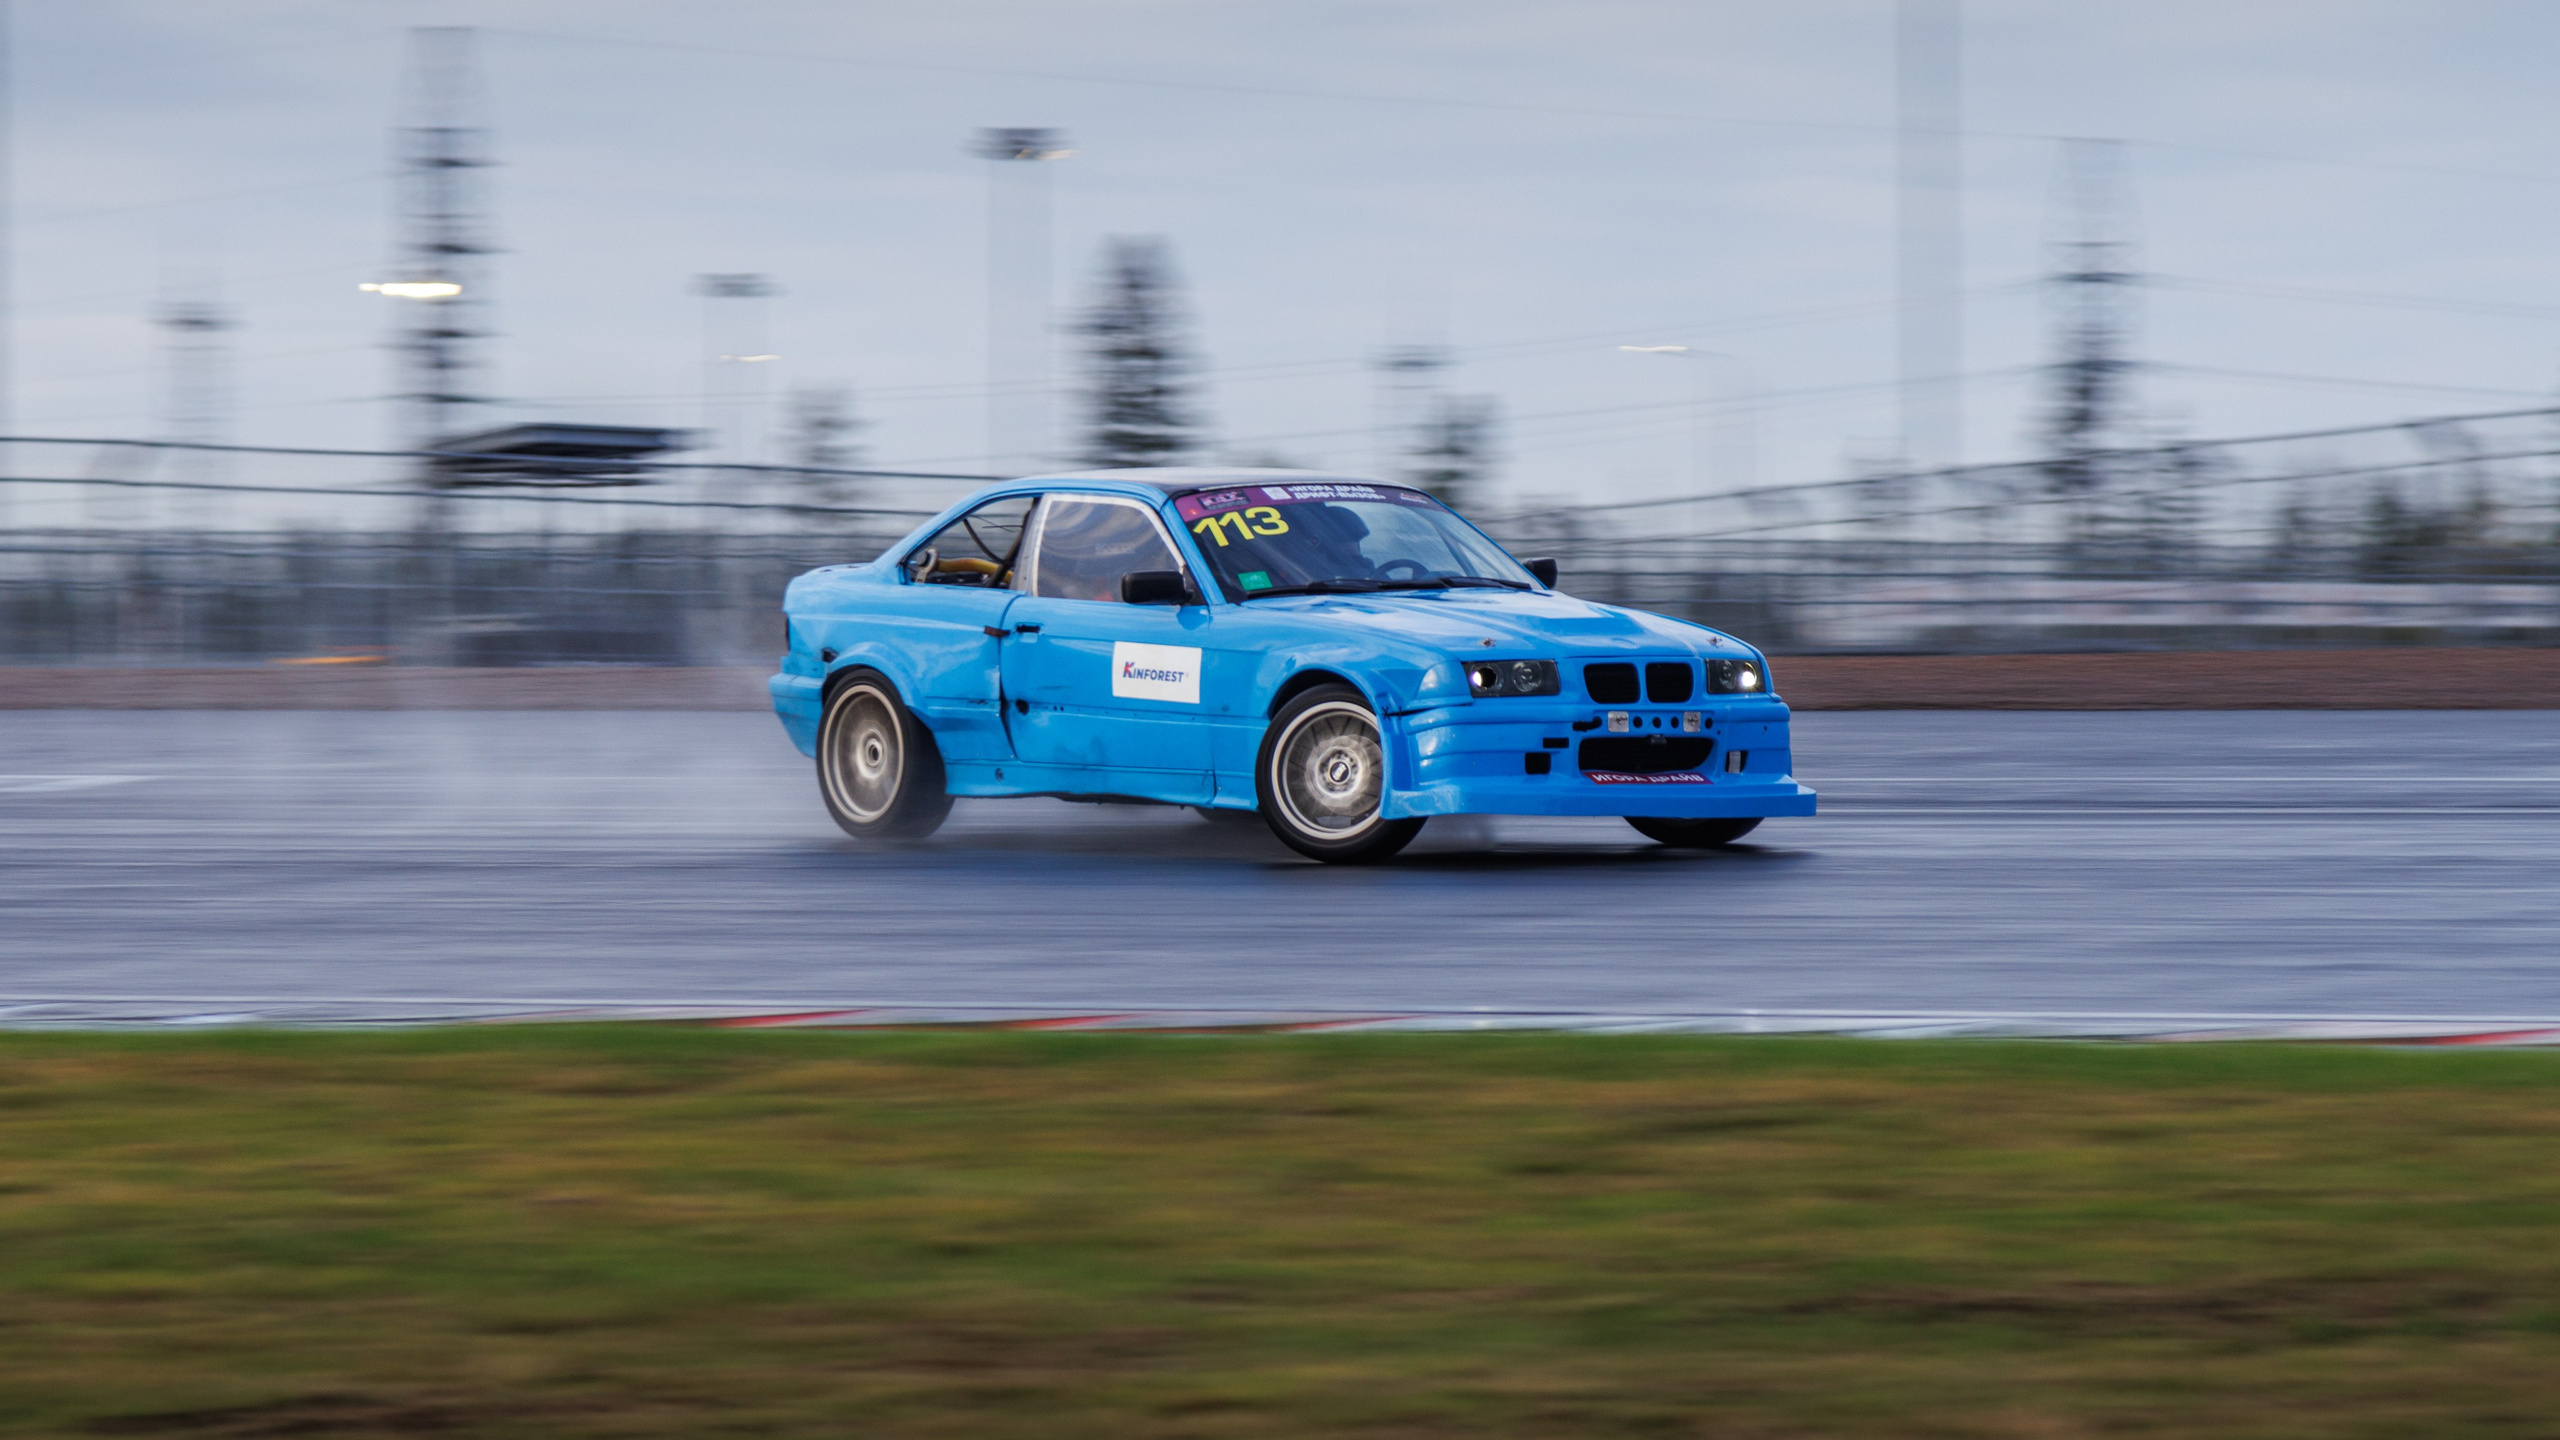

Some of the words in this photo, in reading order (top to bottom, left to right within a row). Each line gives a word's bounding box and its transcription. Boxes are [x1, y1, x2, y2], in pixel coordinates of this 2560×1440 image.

[1334, 485, 1376, 493] ДРАЙВ
[1193, 507, 1289, 547] 113
[1123, 662, 1184, 682] KINFOREST
[1592, 774, 1647, 782] ИГОРА
[1648, 773, 1704, 783] ДРАЙВ
